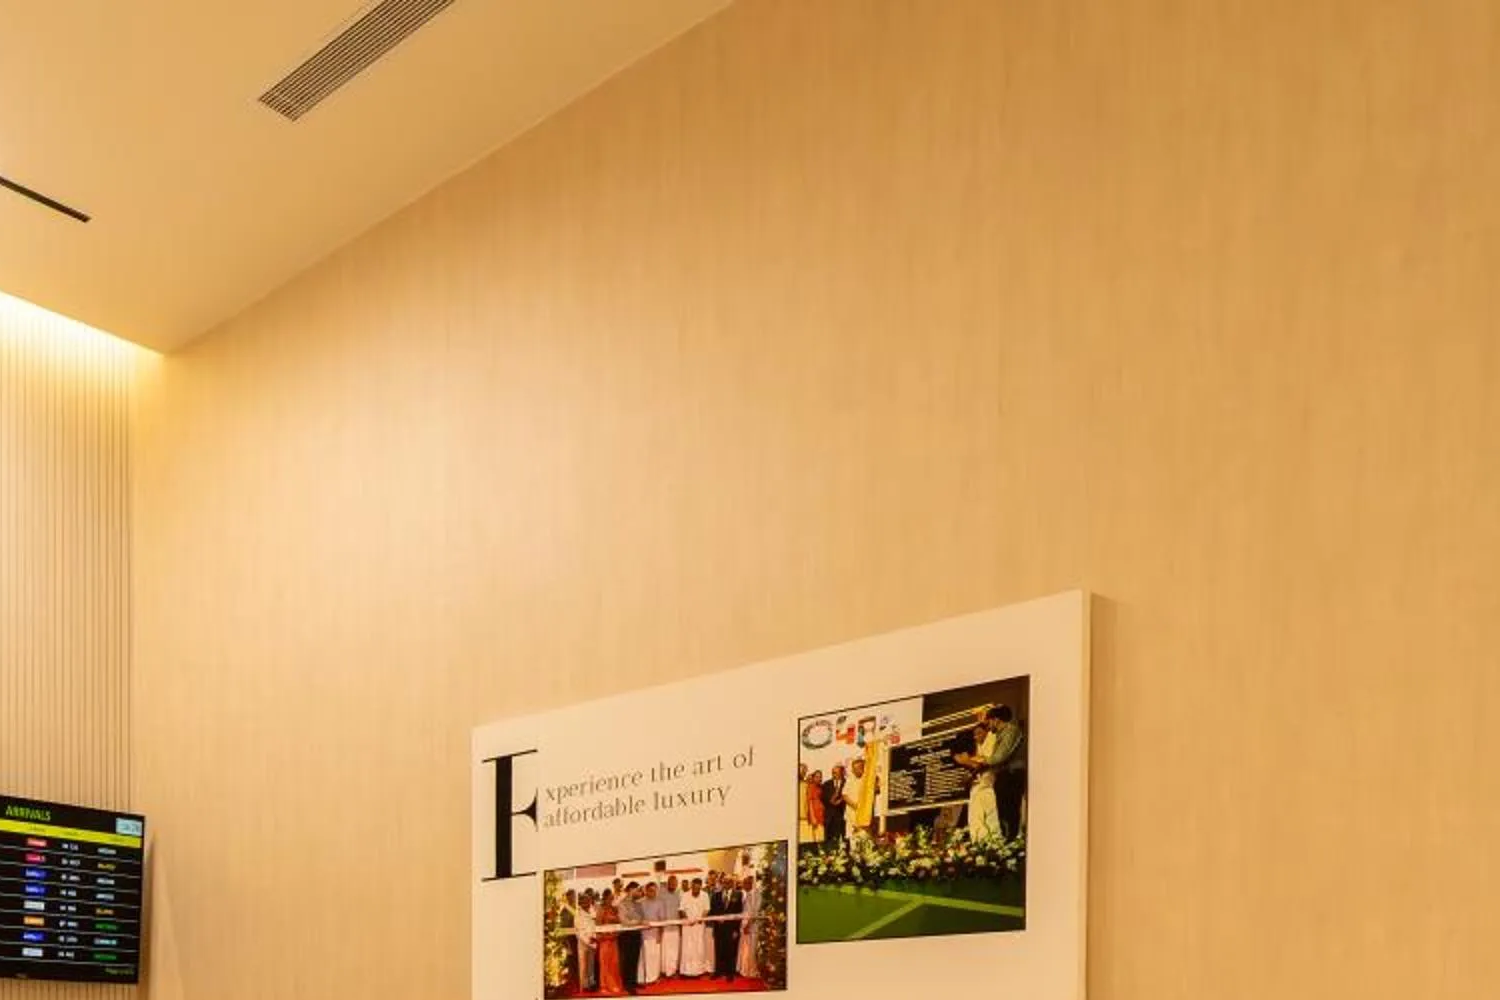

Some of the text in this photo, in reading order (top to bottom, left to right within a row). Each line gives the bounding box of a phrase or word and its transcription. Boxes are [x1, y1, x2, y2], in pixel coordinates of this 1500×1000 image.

[651, 761, 685, 783] the
[691, 754, 724, 776] art
[732, 744, 755, 769] of
[543, 784, 733, 828] affordable luxury
